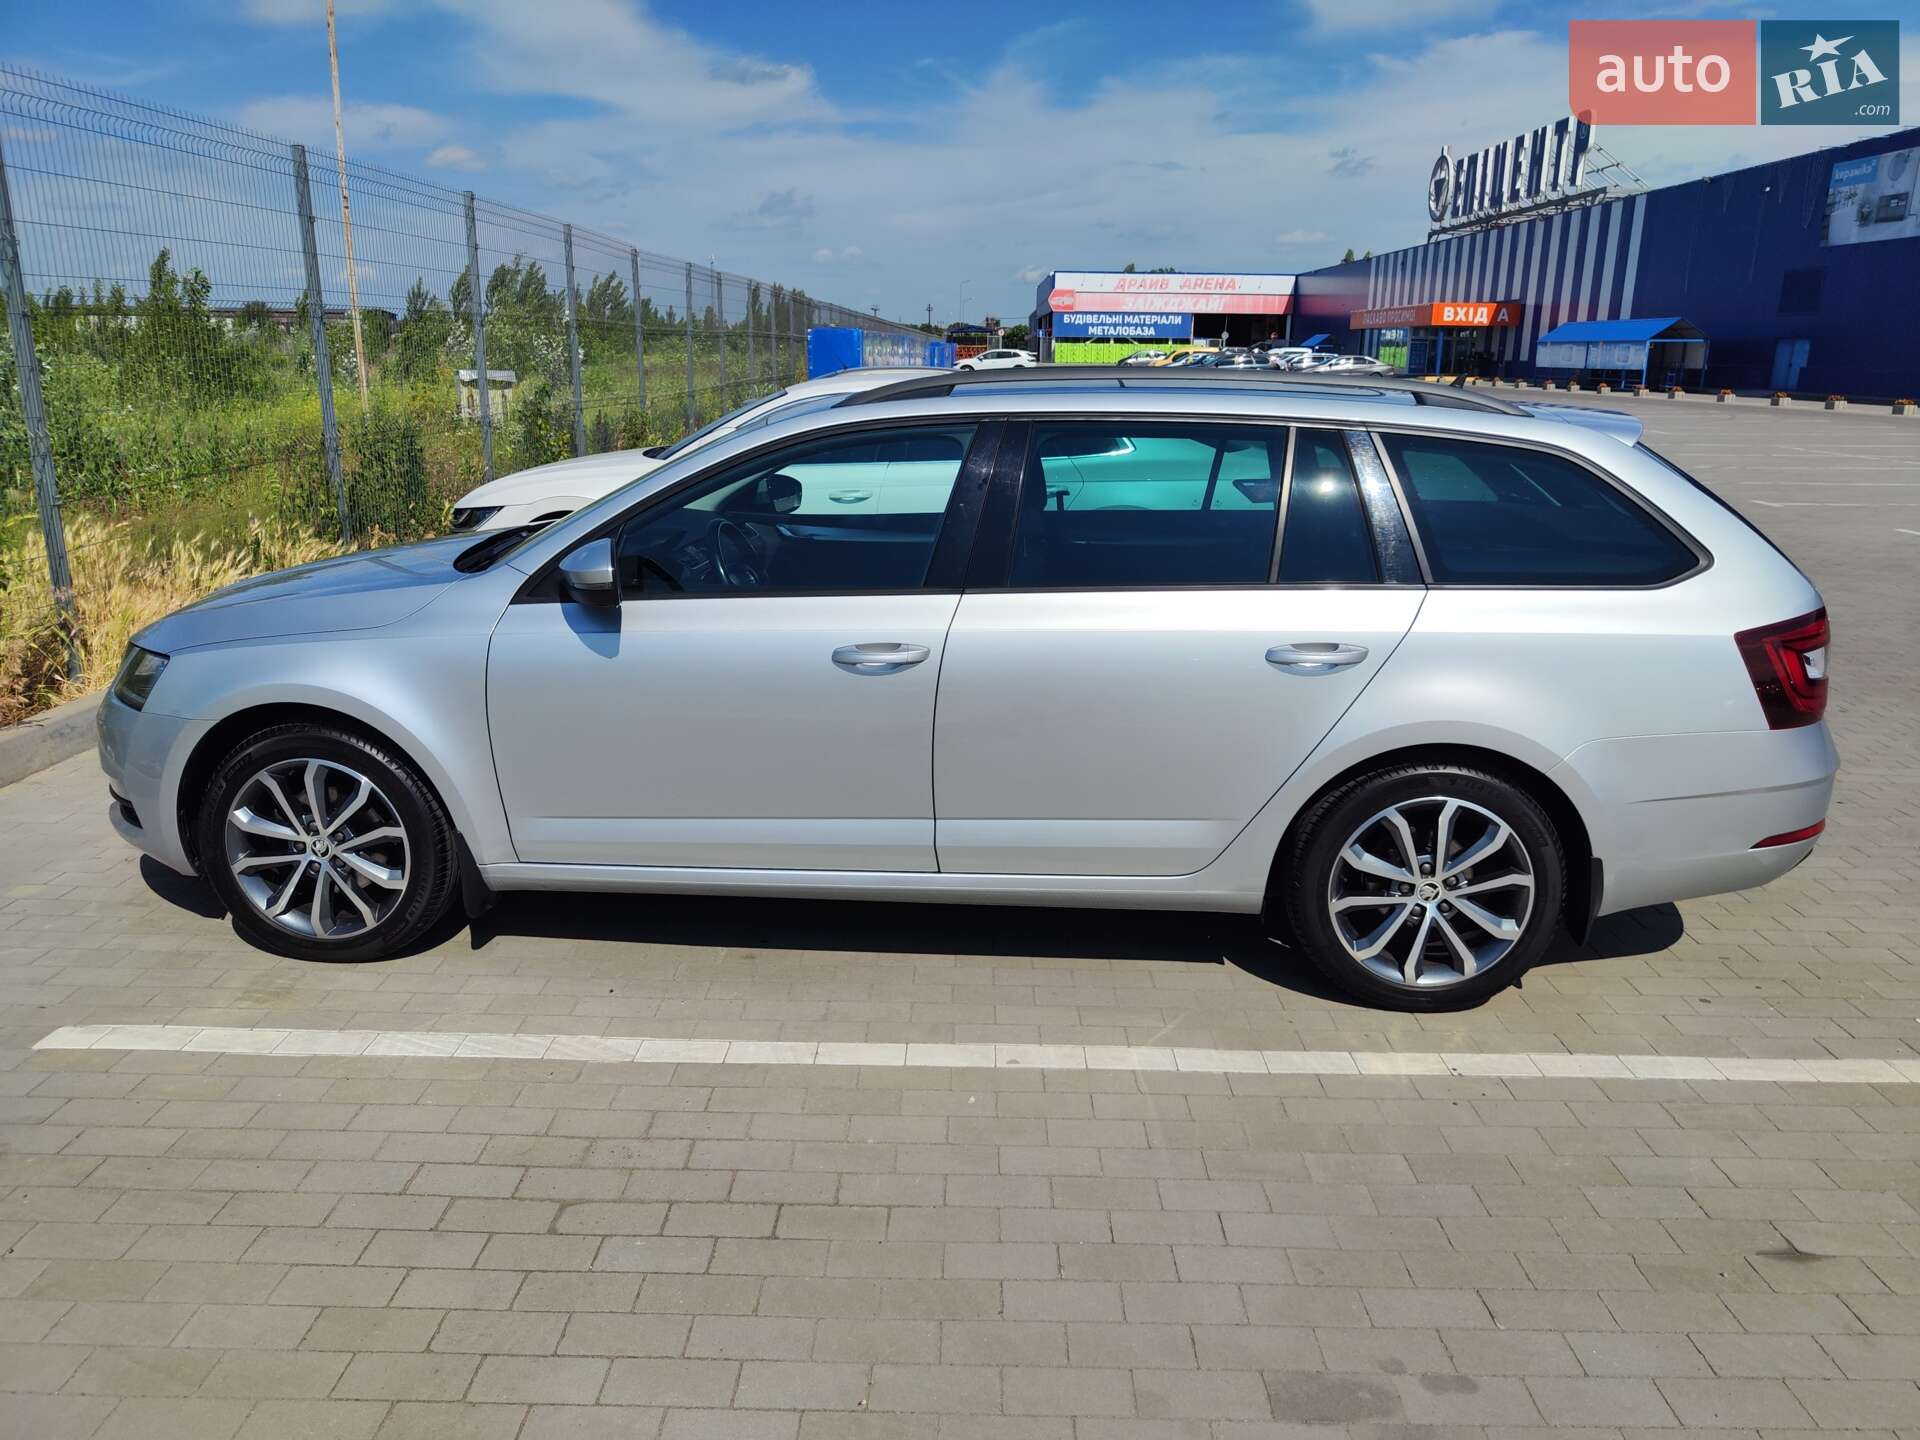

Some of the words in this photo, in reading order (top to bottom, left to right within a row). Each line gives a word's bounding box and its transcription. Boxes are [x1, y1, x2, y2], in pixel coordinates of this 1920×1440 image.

[1450, 110, 1595, 219] ЕПІЦЕНТР
[1180, 278, 1237, 291] ARENA
[1063, 314, 1123, 324] БУДІВЕЛЬНІ
[1124, 315, 1182, 325] МАТЕРІАЛИ
[1443, 307, 1488, 324] ВХІД
[1088, 326, 1156, 336] МЕТАЛОБАЗА
